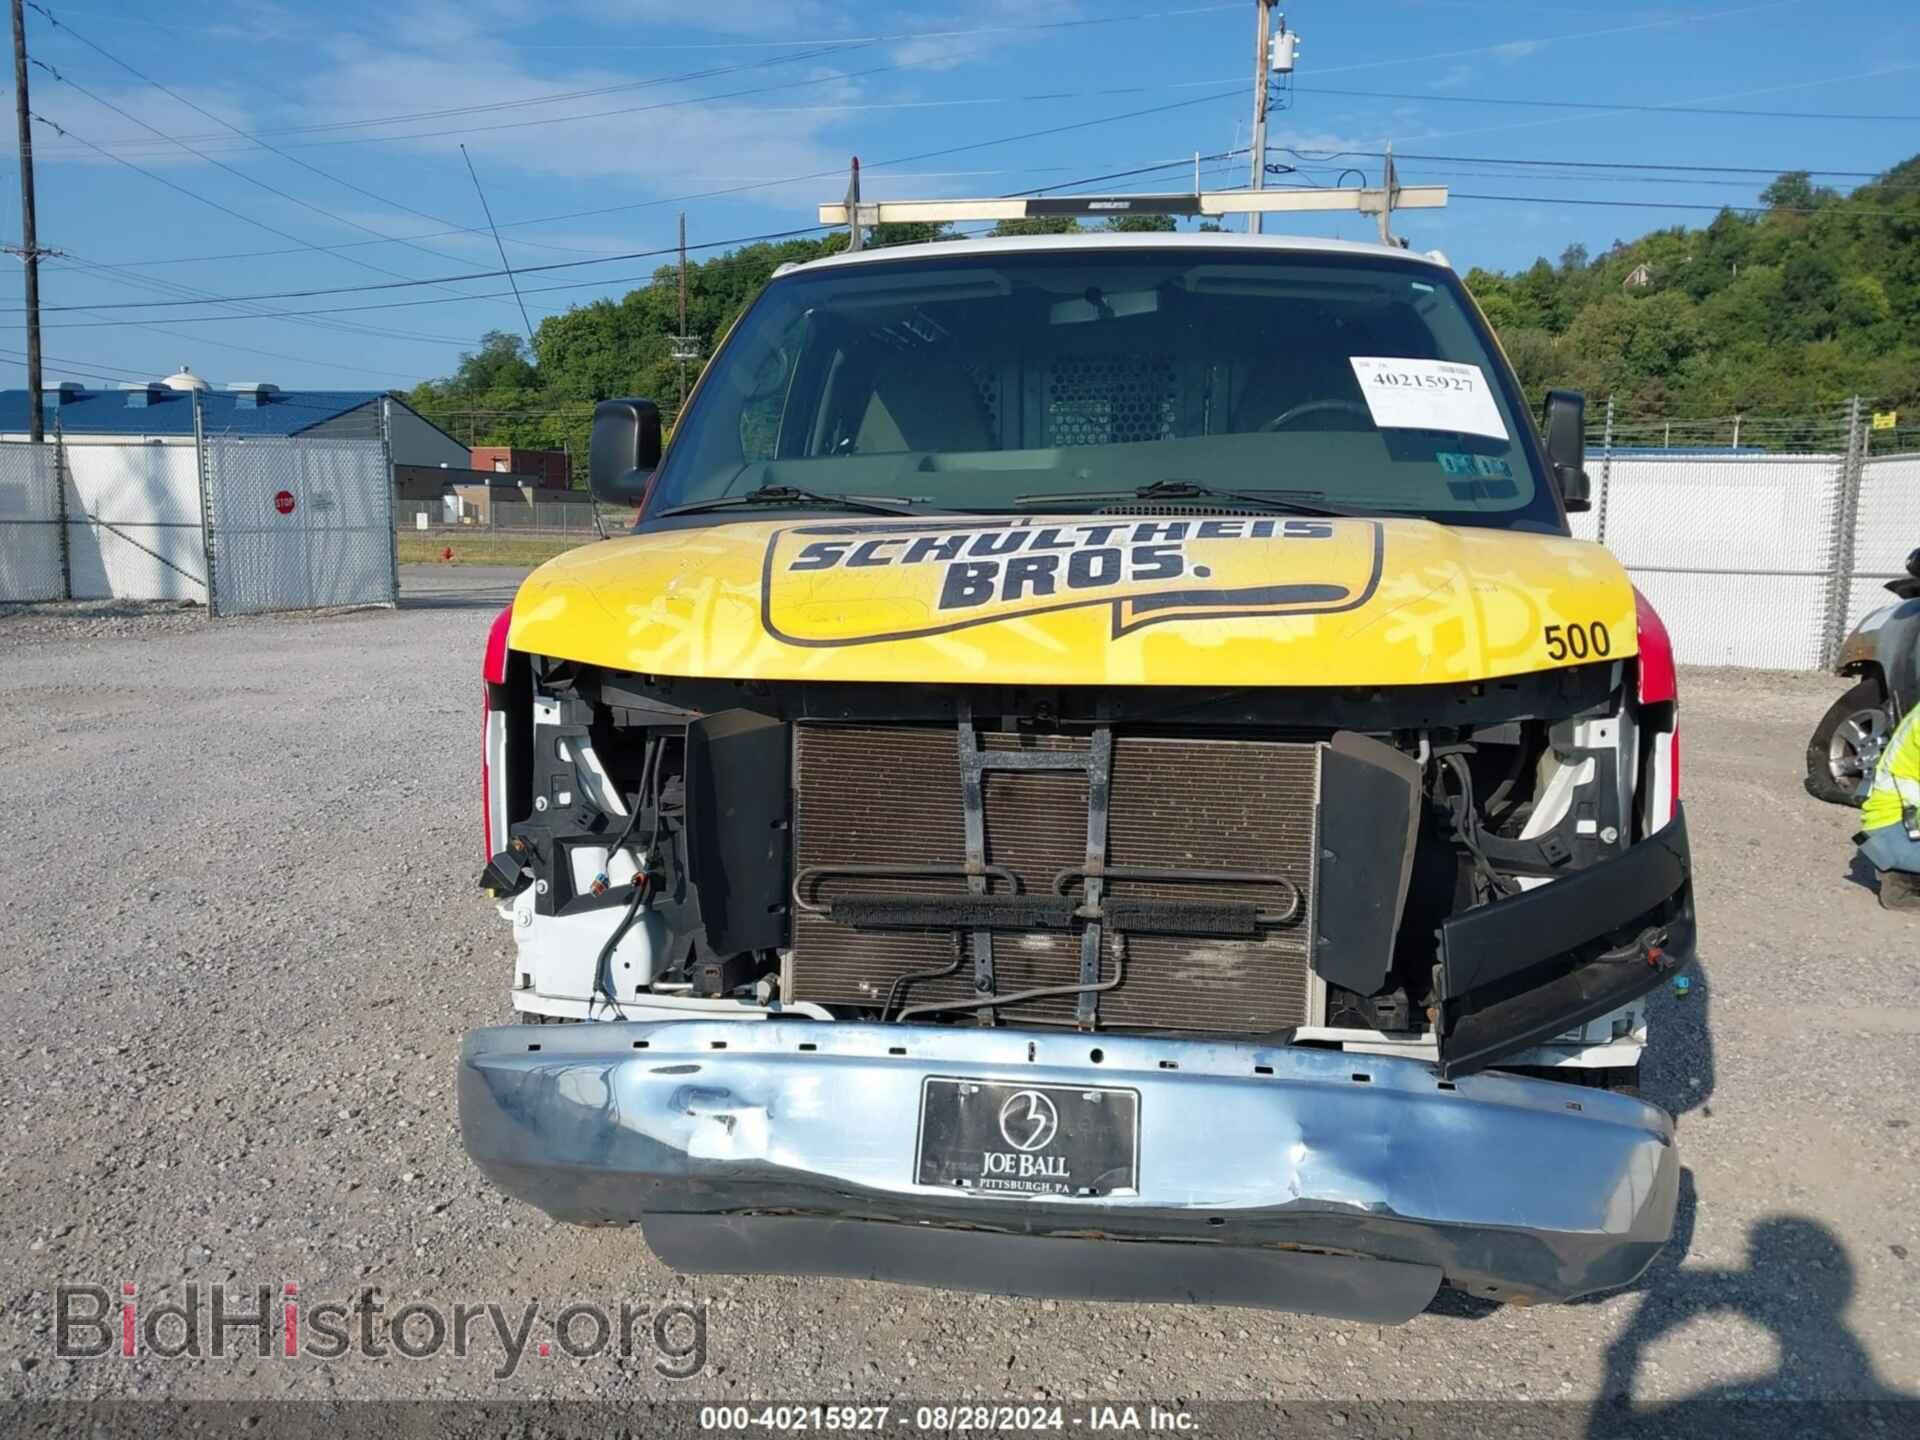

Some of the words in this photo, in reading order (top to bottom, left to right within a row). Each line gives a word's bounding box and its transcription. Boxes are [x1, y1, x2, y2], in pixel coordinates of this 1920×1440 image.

[1374, 373, 1473, 392] 40215927
[275, 497, 295, 508] STOP
[789, 519, 1333, 571] SCHULTHEIS
[938, 545, 1212, 610] BROS.
[1544, 621, 1610, 660] 500
[981, 1152, 1017, 1176] JOE
[1019, 1153, 1070, 1177] BALL
[1055, 1183, 1070, 1193] PA
